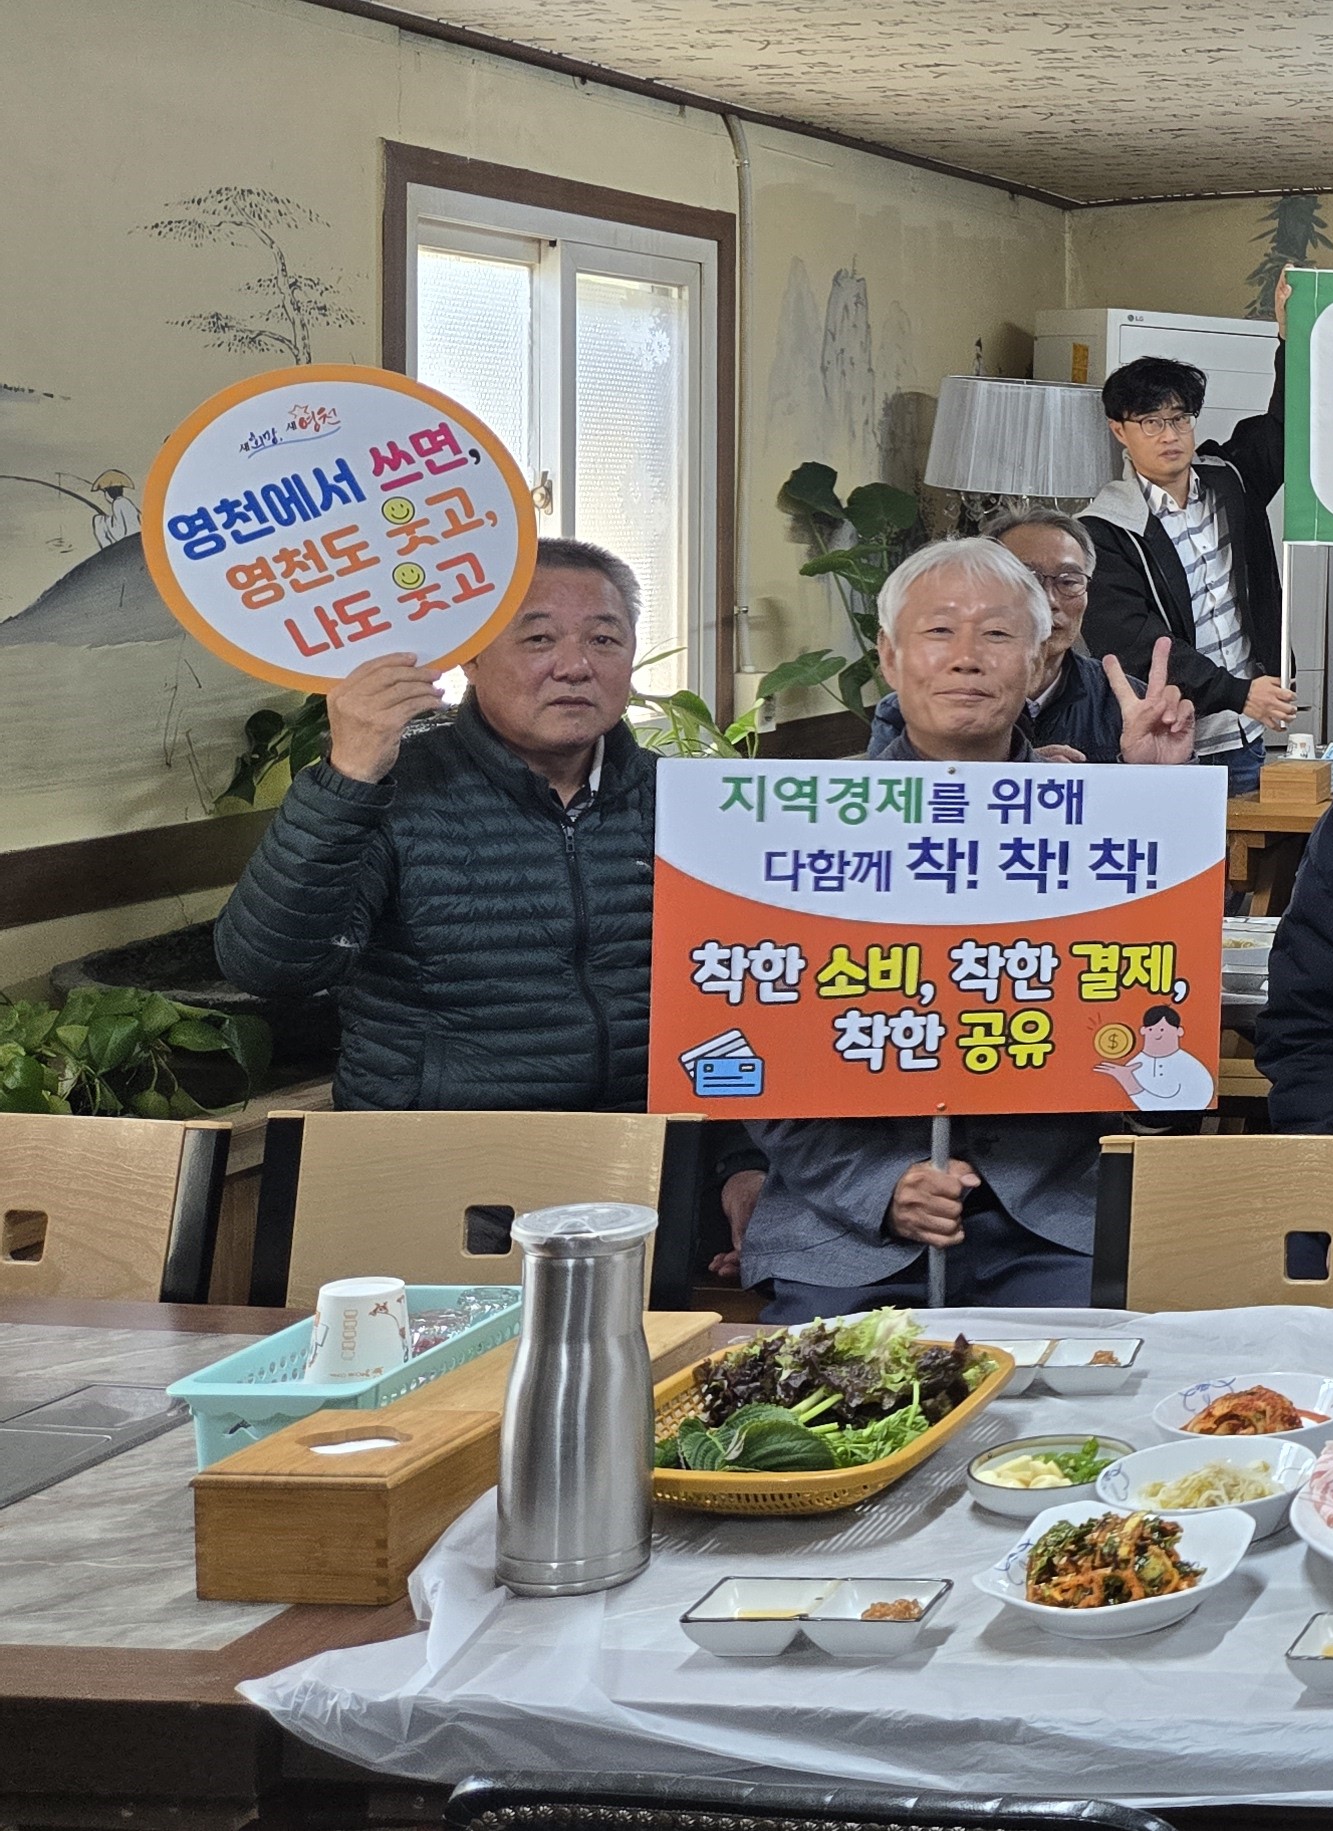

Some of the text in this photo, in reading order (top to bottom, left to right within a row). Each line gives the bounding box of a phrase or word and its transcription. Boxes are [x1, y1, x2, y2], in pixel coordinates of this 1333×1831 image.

[167, 421, 482, 561] 영천에서 쓰면,
[225, 522, 381, 611] 영천도
[284, 588, 393, 659] 나도
[719, 775, 1084, 827] 지역경제를 위해
[763, 837, 1158, 894] 다함께 착! 착! 착!
[690, 939, 1189, 1007] 착한 소비, 착한 결제,
[834, 1008, 1055, 1074] 착한 공유
